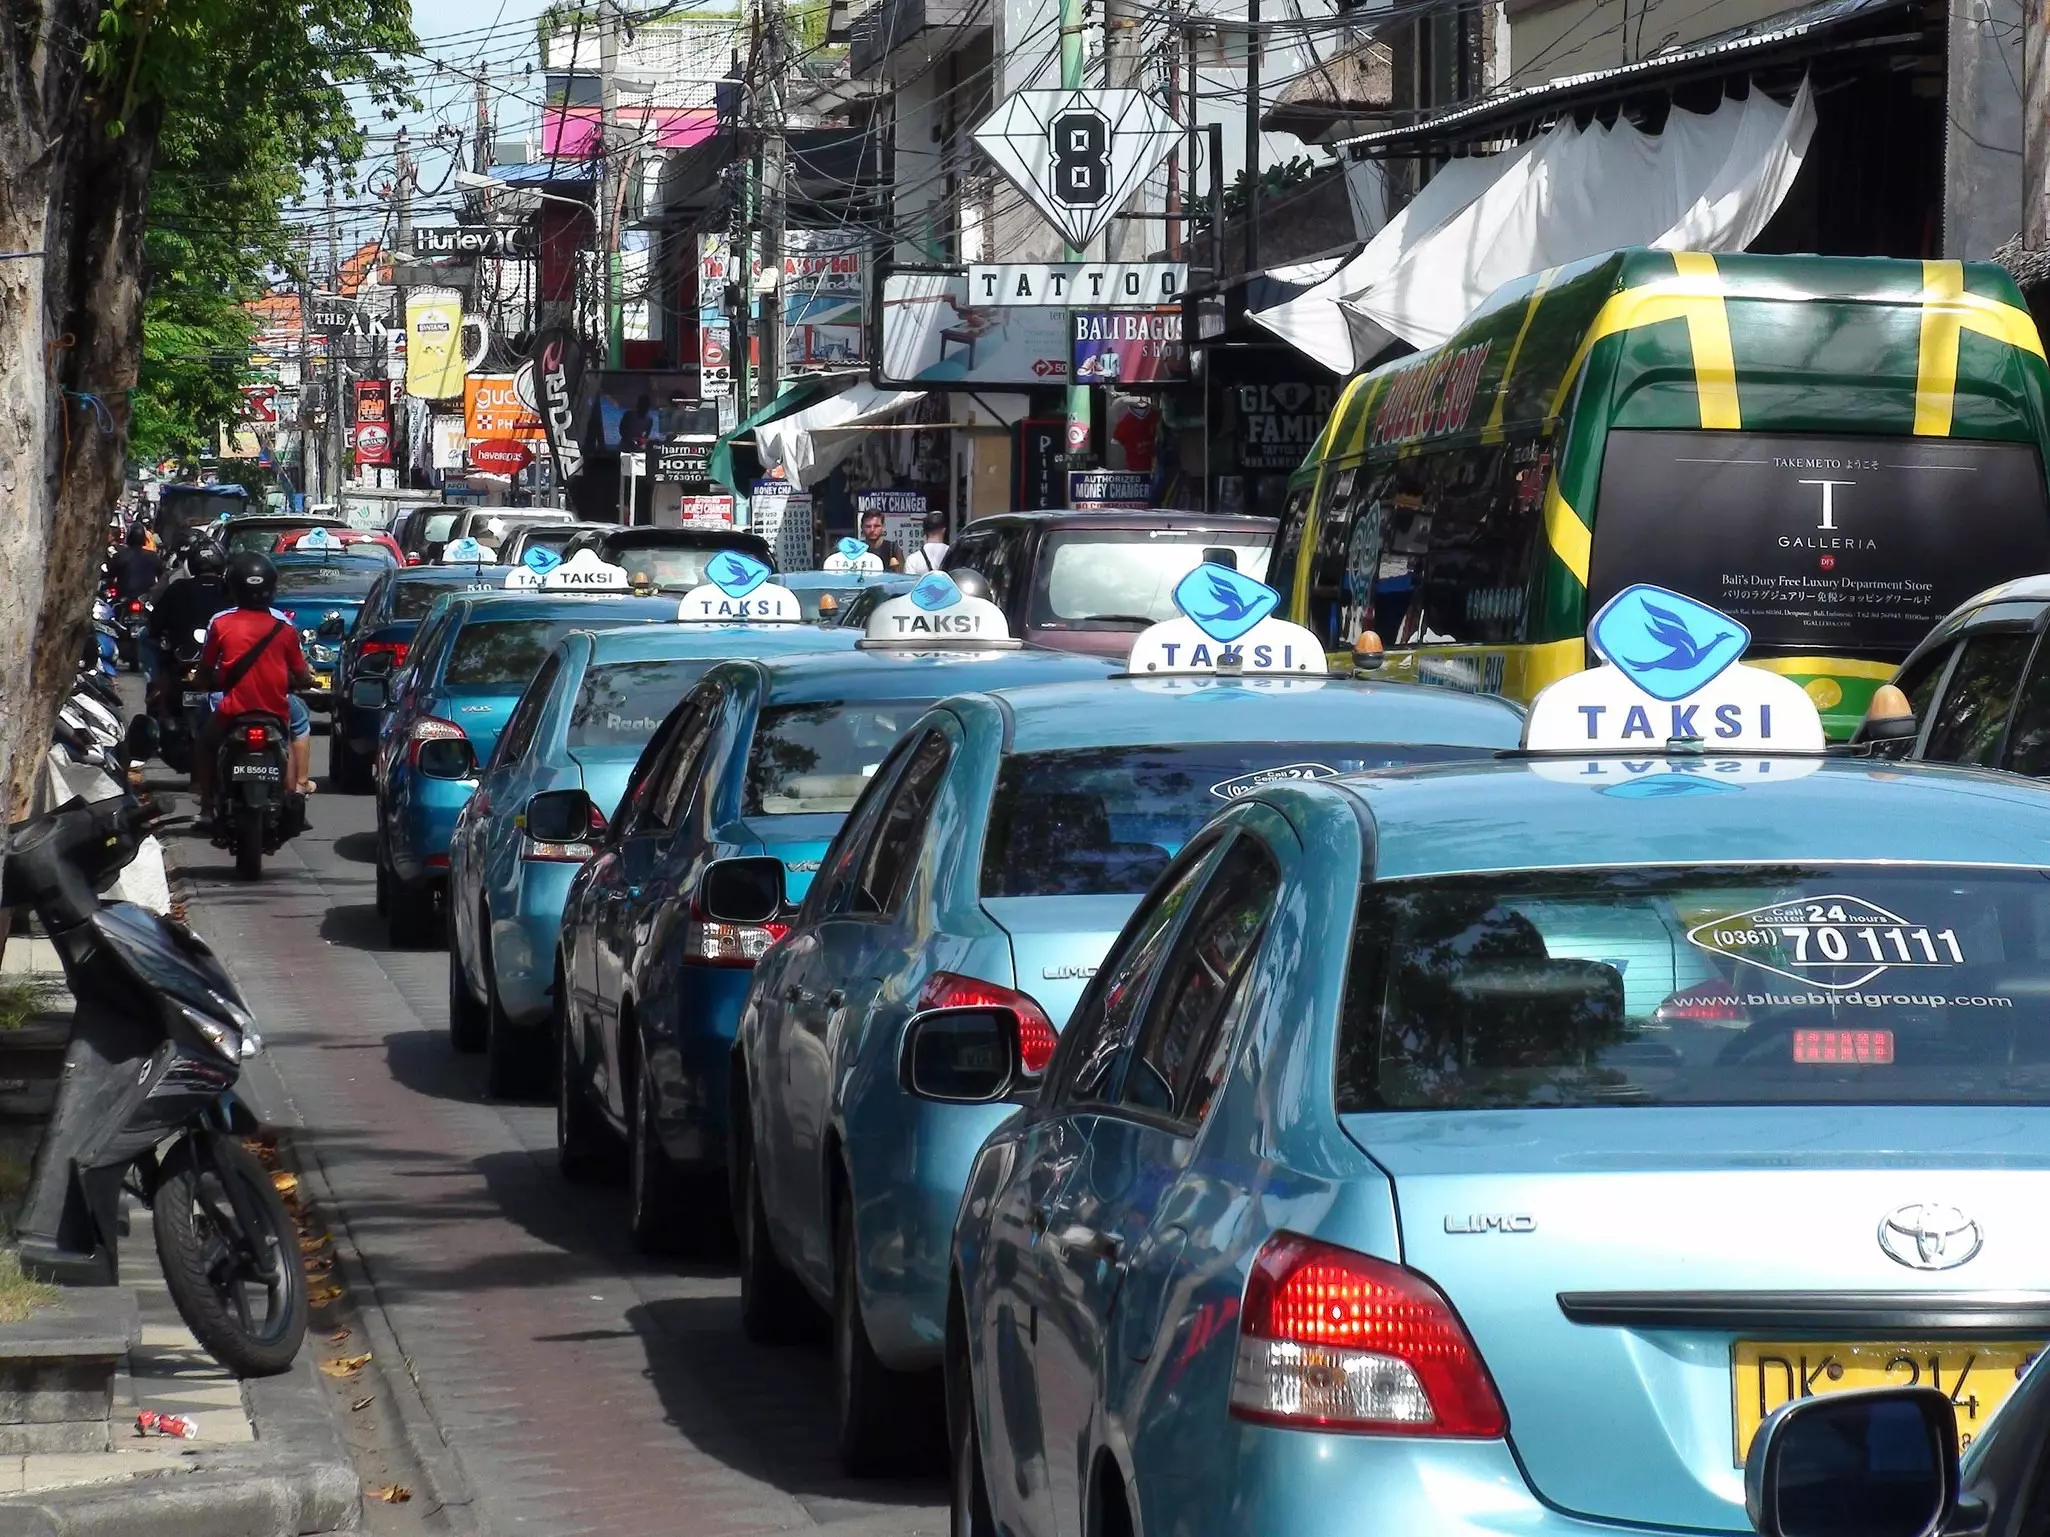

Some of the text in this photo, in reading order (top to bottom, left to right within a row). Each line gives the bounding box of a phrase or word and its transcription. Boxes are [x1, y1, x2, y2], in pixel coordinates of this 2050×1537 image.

[1048, 108, 1111, 209] 8
[418, 230, 491, 252] Hurley
[981, 271, 1177, 297] TATTOO
[315, 313, 346, 325] THE
[1076, 315, 1184, 341] BALI BAGUS
[661, 444, 713, 456] harmony
[658, 459, 708, 470] HOTE
[1773, 457, 1841, 469] TAKE ME TO
[1084, 475, 1142, 483] AUTHORIZED
[753, 486, 778, 495] MONEY
[1075, 484, 1150, 498] MONEY CHANGER
[858, 496, 927, 512] MONEY CHANGER
[1798, 479, 1856, 529] T
[1777, 536, 1877, 550] GALLERIA
[835, 560, 874, 568] TAKSI
[1820, 557, 1835, 566] DFS
[518, 575, 548, 585] TAK
[560, 573, 613, 584] TAKSI
[1722, 574, 1933, 591] Bali's Duty Free Luxury Department Store
[700, 600, 782, 616] TAKSI
[892, 615, 981, 633] TAKSI
[1161, 643, 1293, 669] TAKSI
[1578, 703, 1771, 740] TAKSI
[233, 766, 245, 774] DK
[1288, 769, 1316, 780] 24
[1752, 904, 1889, 924] Center 24 hours
[1772, 907, 1804, 916] Call
[1712, 927, 1965, 964] (0361) 70 1111
[1043, 965, 1099, 980] LIMO
[1673, 992, 2014, 1008] www.bluebirdgroup.com
[1444, 1212, 1538, 1235] LIMO
[1758, 1355, 1837, 1419] DK
